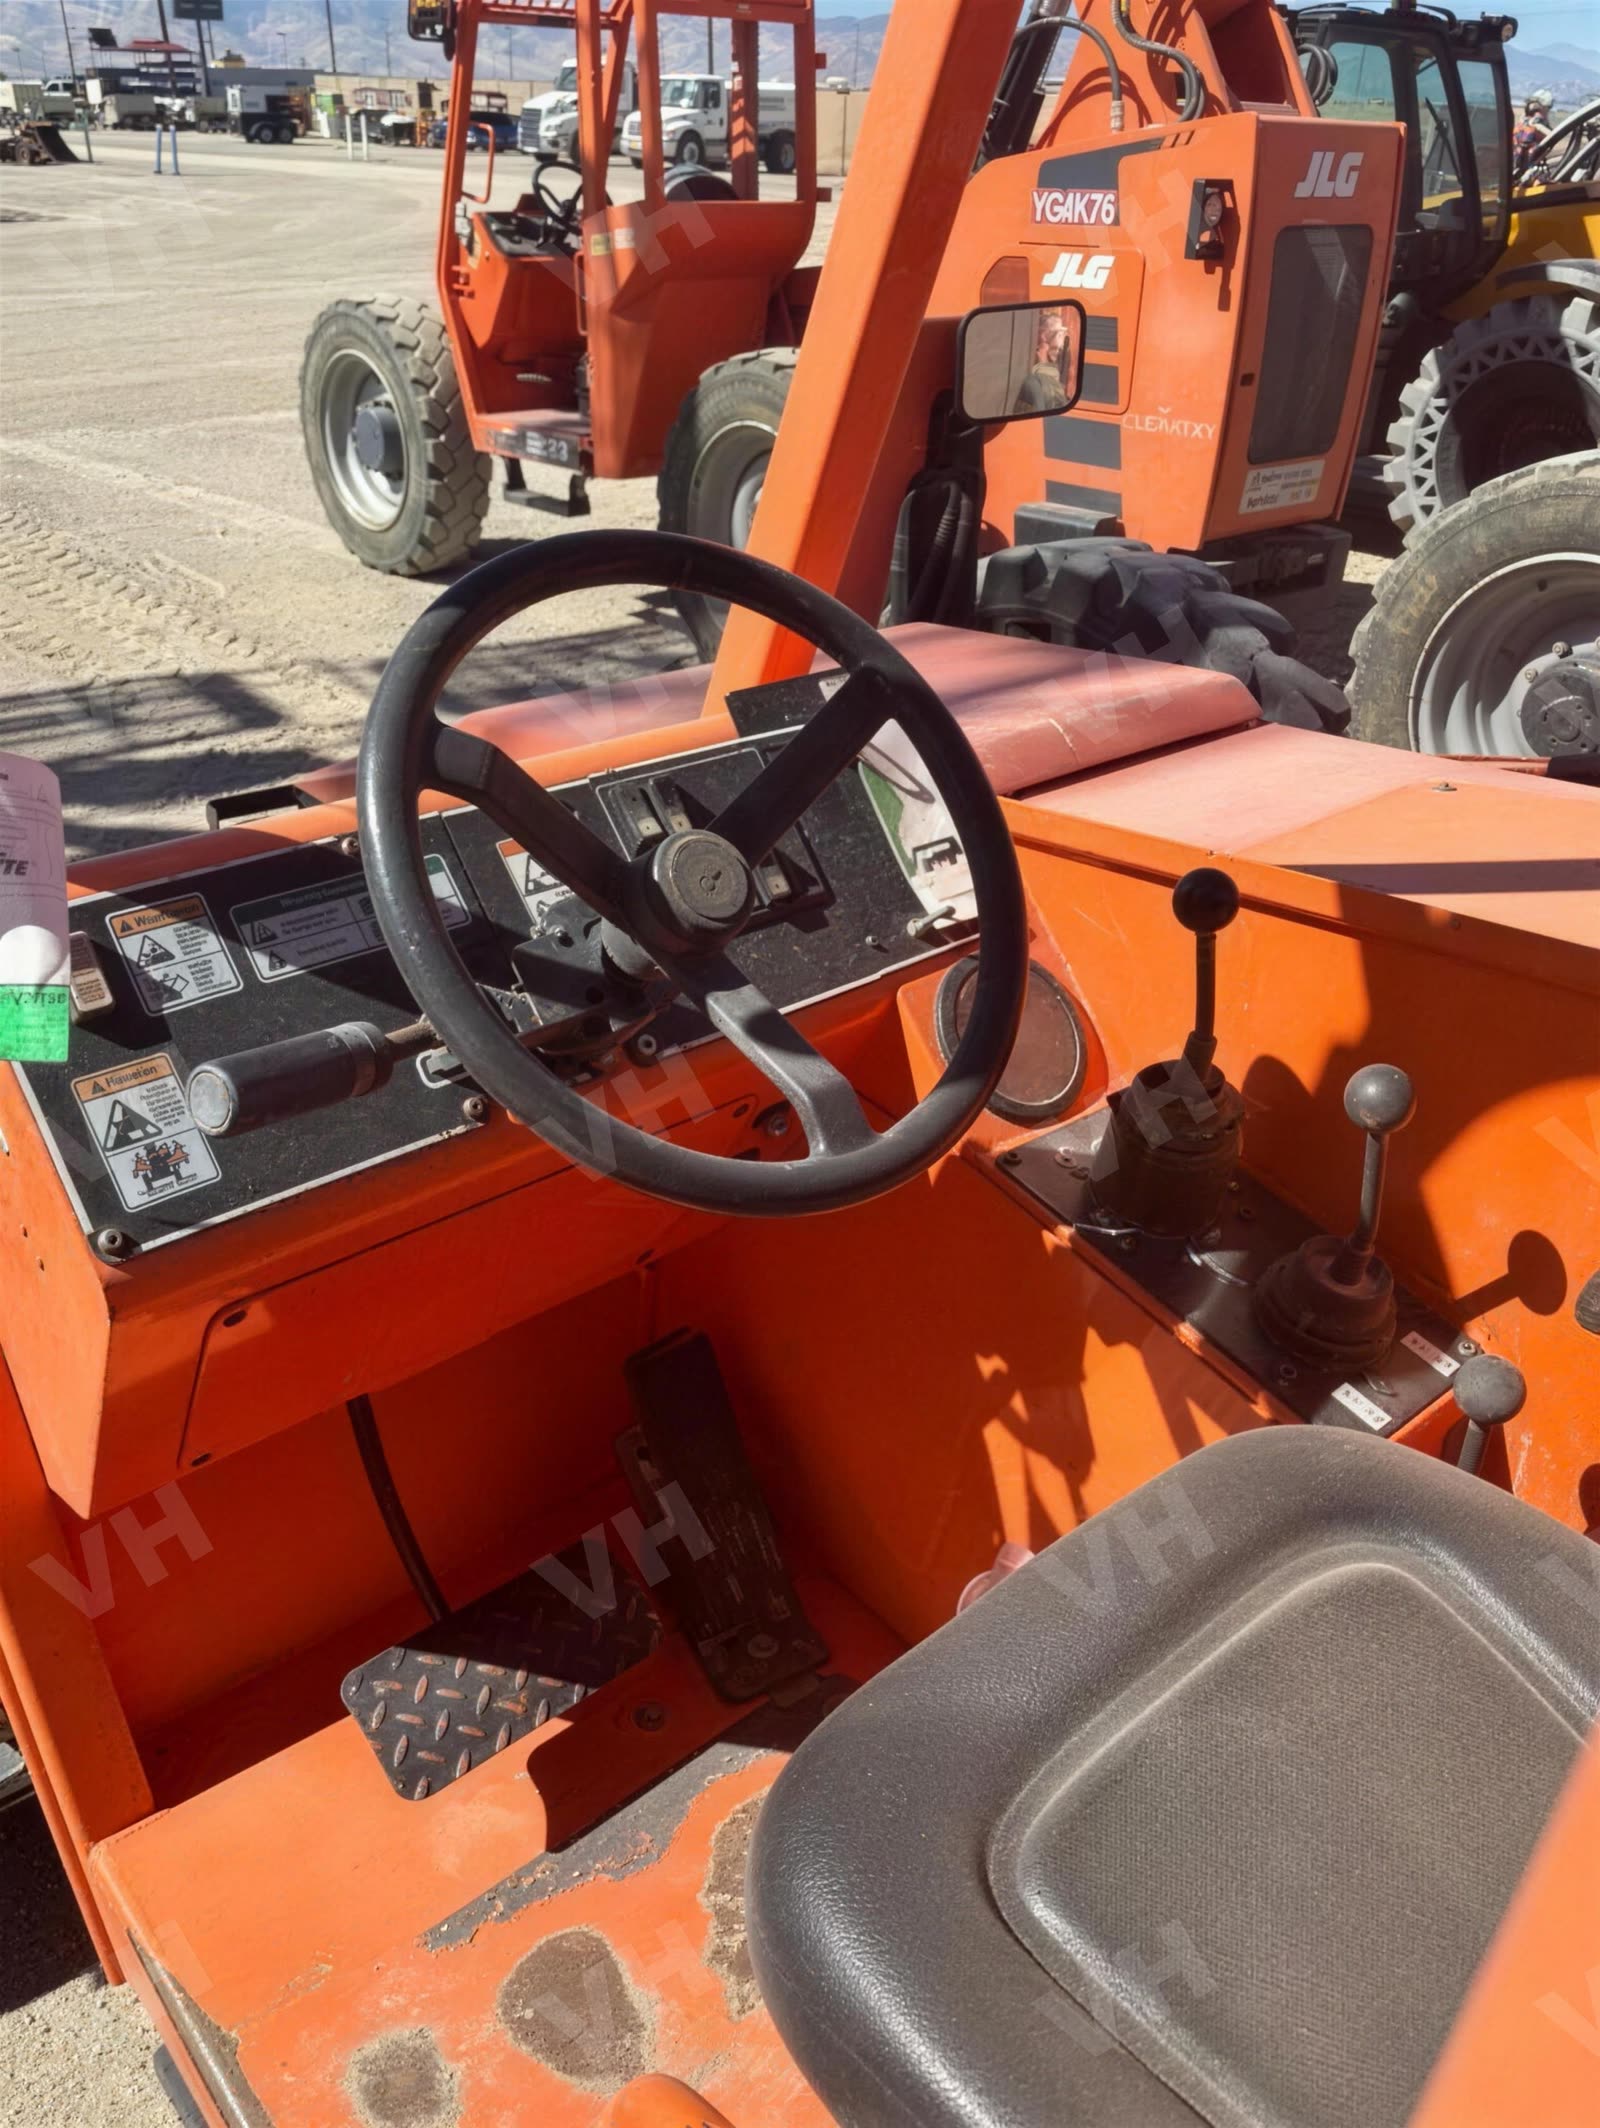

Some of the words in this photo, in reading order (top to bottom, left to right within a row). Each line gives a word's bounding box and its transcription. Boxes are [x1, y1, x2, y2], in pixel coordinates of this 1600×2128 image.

[1294, 151, 1364, 198] JLG
[1032, 190, 1115, 225] YGAK76
[1041, 252, 1115, 290] JLG
